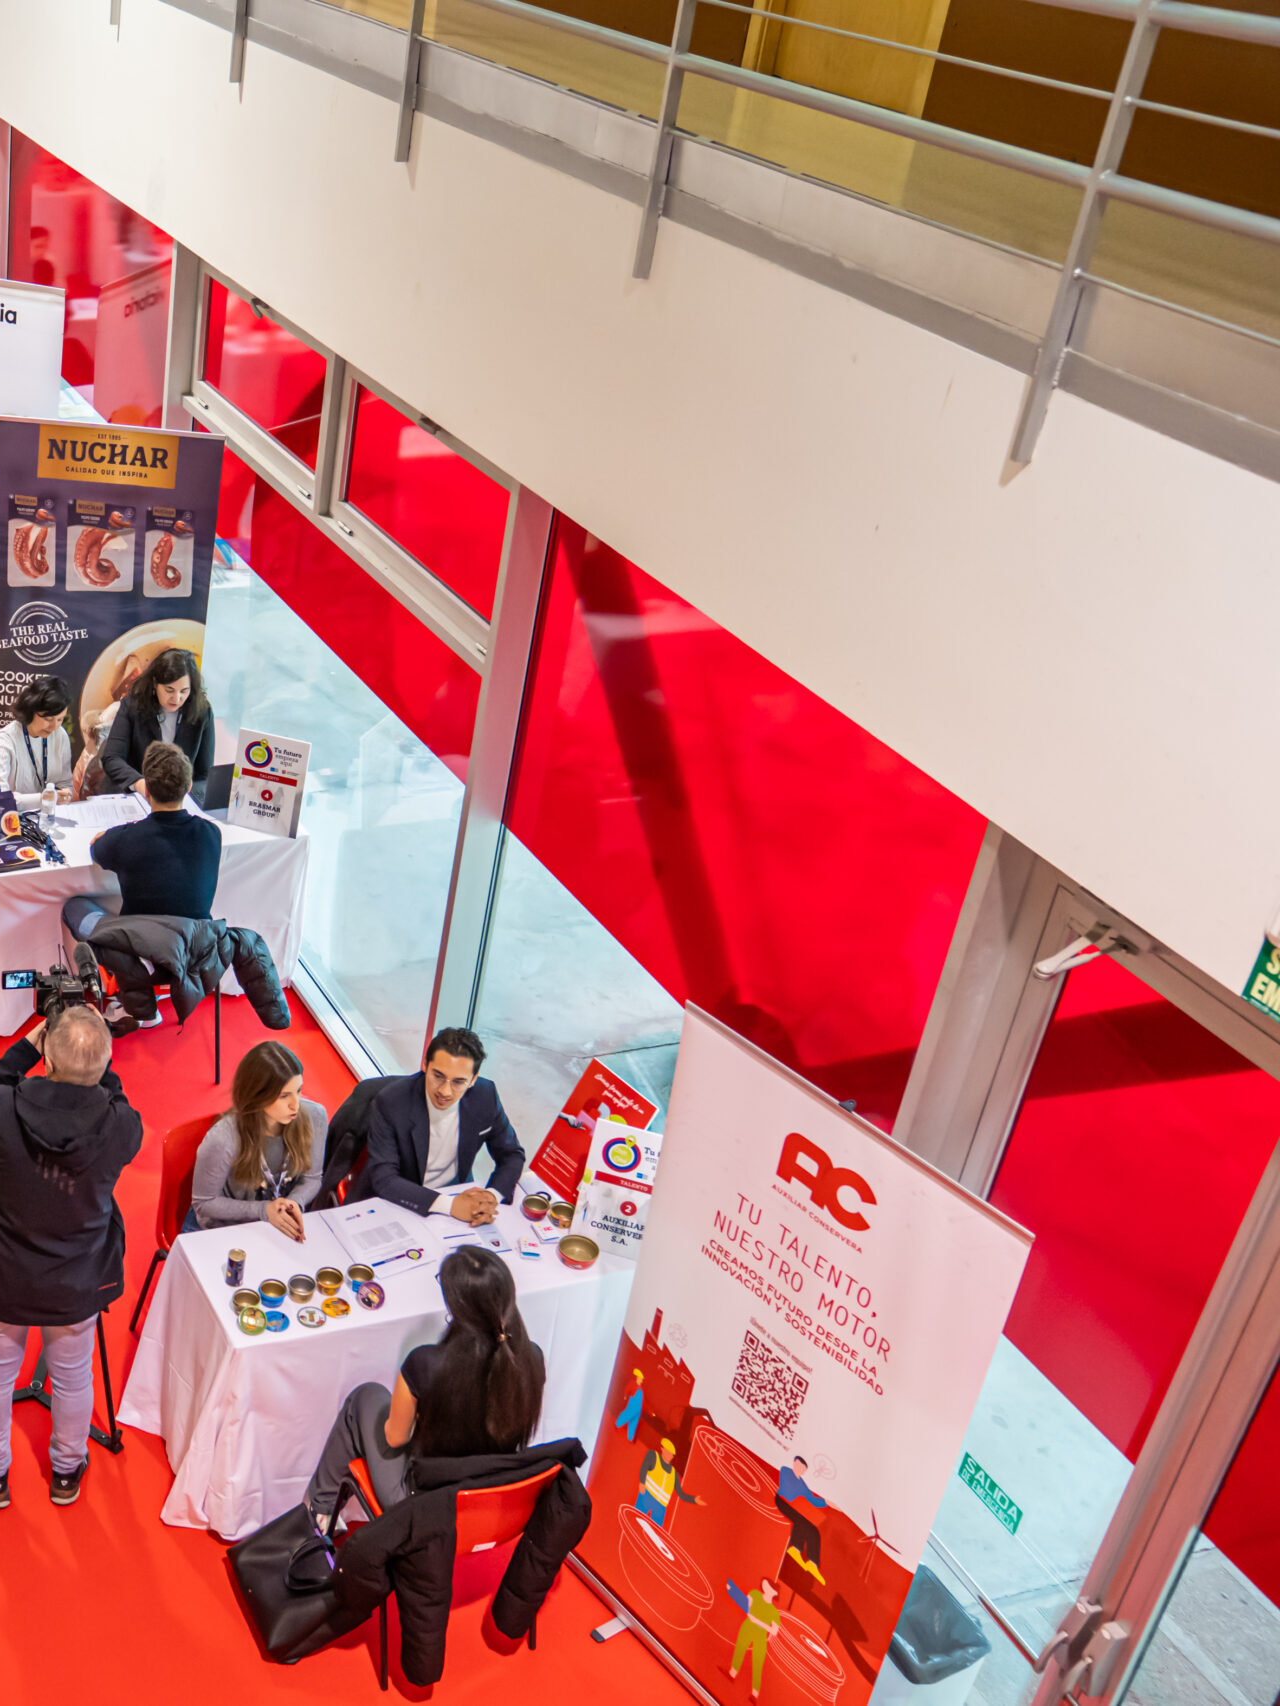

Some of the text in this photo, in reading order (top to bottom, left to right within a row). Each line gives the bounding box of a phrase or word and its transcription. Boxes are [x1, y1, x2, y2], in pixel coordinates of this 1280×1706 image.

[48, 439, 168, 469] NUCHAR
[65, 466, 97, 474] CALIDAD
[119, 471, 148, 479] INSPIRA
[10, 621, 69, 638] THE REAL
[51, 629, 88, 643] TASTE
[283, 748, 302, 758] futuro
[1250, 973, 1280, 1015] EM
[644, 1146, 655, 1156] Tu
[620, 1180, 648, 1191] TALENTO
[625, 1205, 632, 1213] 2
[737, 1192, 762, 1226] TU
[771, 1184, 863, 1254] AUXILIAR CONSERVERA
[714, 1210, 891, 1363] NUESTRO MOTOR
[701, 1245, 884, 1396] INNOVACIÓN Y SOSTENIBILIDAD
[709, 1240, 878, 1378] CREAMOS FUTURO DESDE LA
[961, 1468, 1015, 1534] DE EMERGENCIA
[965, 1457, 1018, 1523] SALIDA
